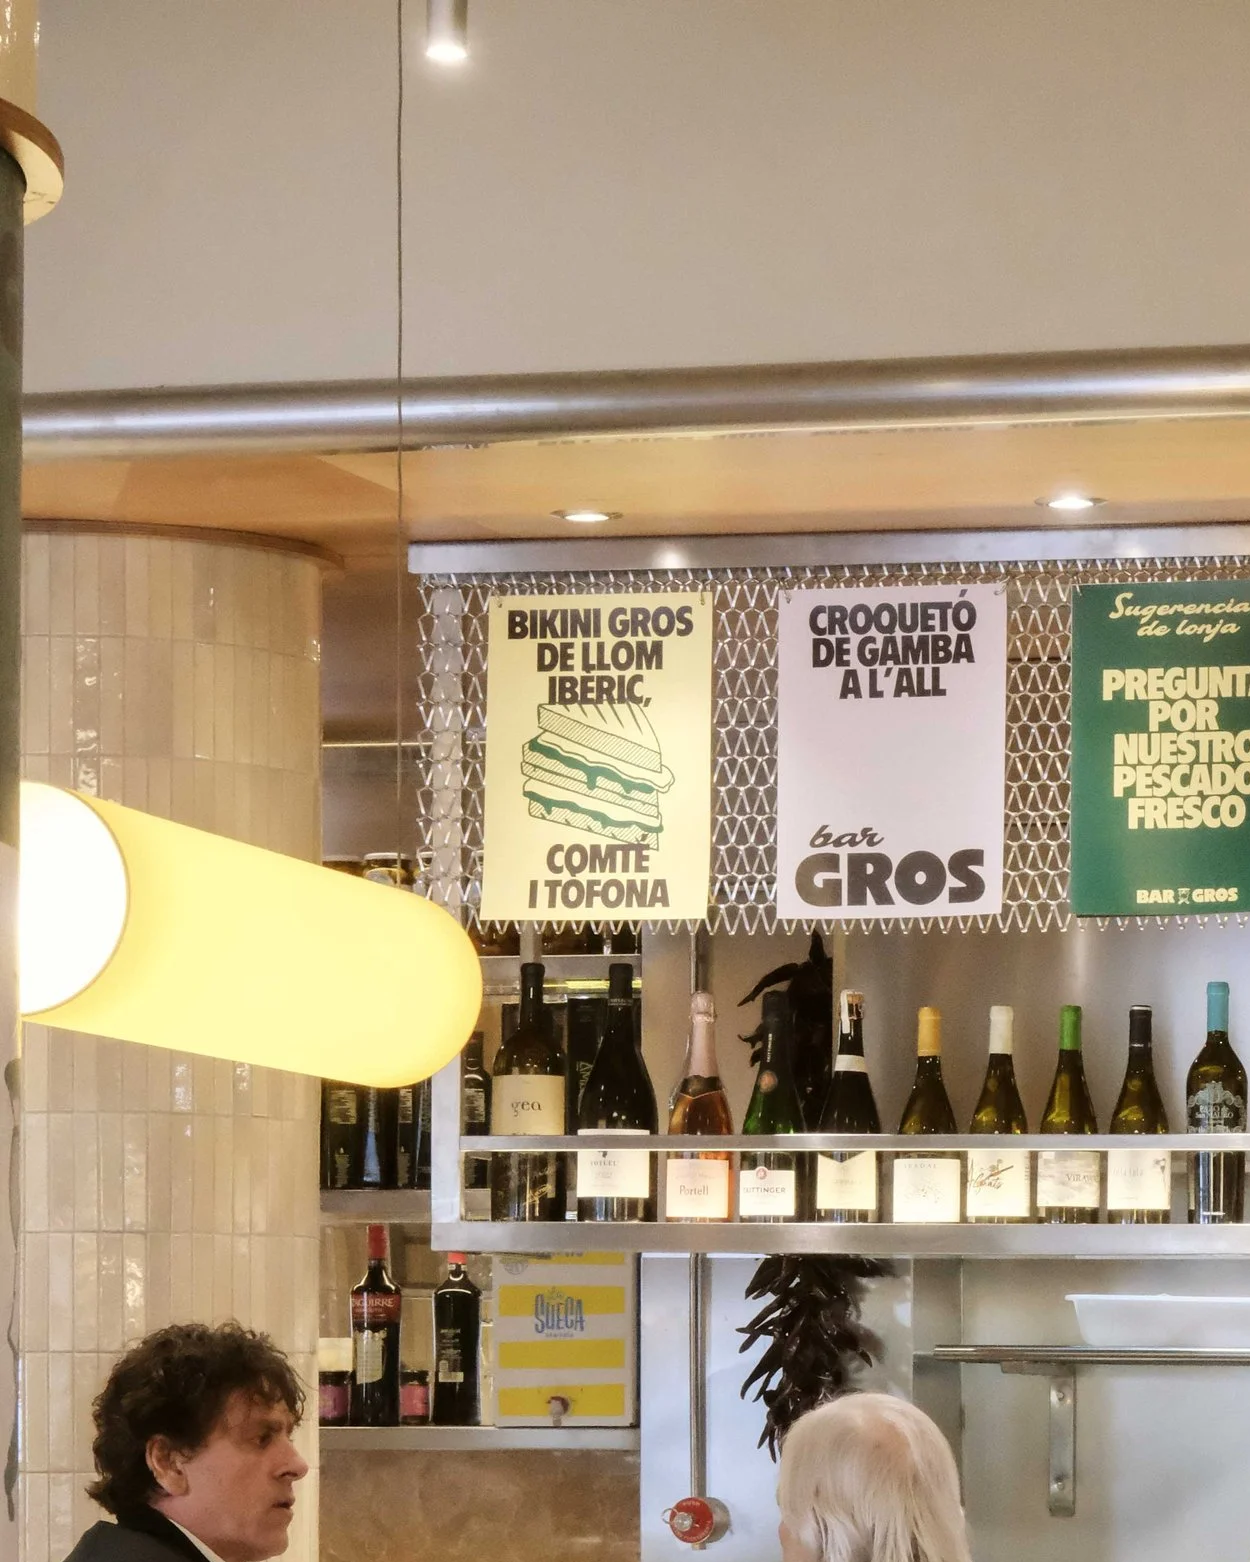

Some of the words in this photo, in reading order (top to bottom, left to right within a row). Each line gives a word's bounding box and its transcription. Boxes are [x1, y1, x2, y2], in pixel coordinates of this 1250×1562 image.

[507, 607, 602, 640] BIKINI
[607, 605, 694, 638] GROS
[808, 588, 977, 636] CROQUETÓ
[1136, 620, 1172, 637] de
[1175, 619, 1241, 643] lonja
[536, 641, 575, 672] DE
[581, 640, 664, 672] LLOM
[812, 636, 851, 668] DE
[856, 633, 976, 667] GAMBA
[839, 668, 863, 700] A
[868, 666, 947, 699] L'ALL
[1148, 699, 1220, 732] POR
[1127, 795, 1247, 830] FRESCO
[808, 824, 885, 848] bar
[546, 834, 651, 875] COMTÉ
[528, 879, 539, 909] I
[794, 848, 986, 908] GROS
[1136, 889, 1175, 904] BAR
[1191, 887, 1239, 903] GROS
[679, 1185, 709, 1197] Portell
[534, 1293, 585, 1333] SUECA
